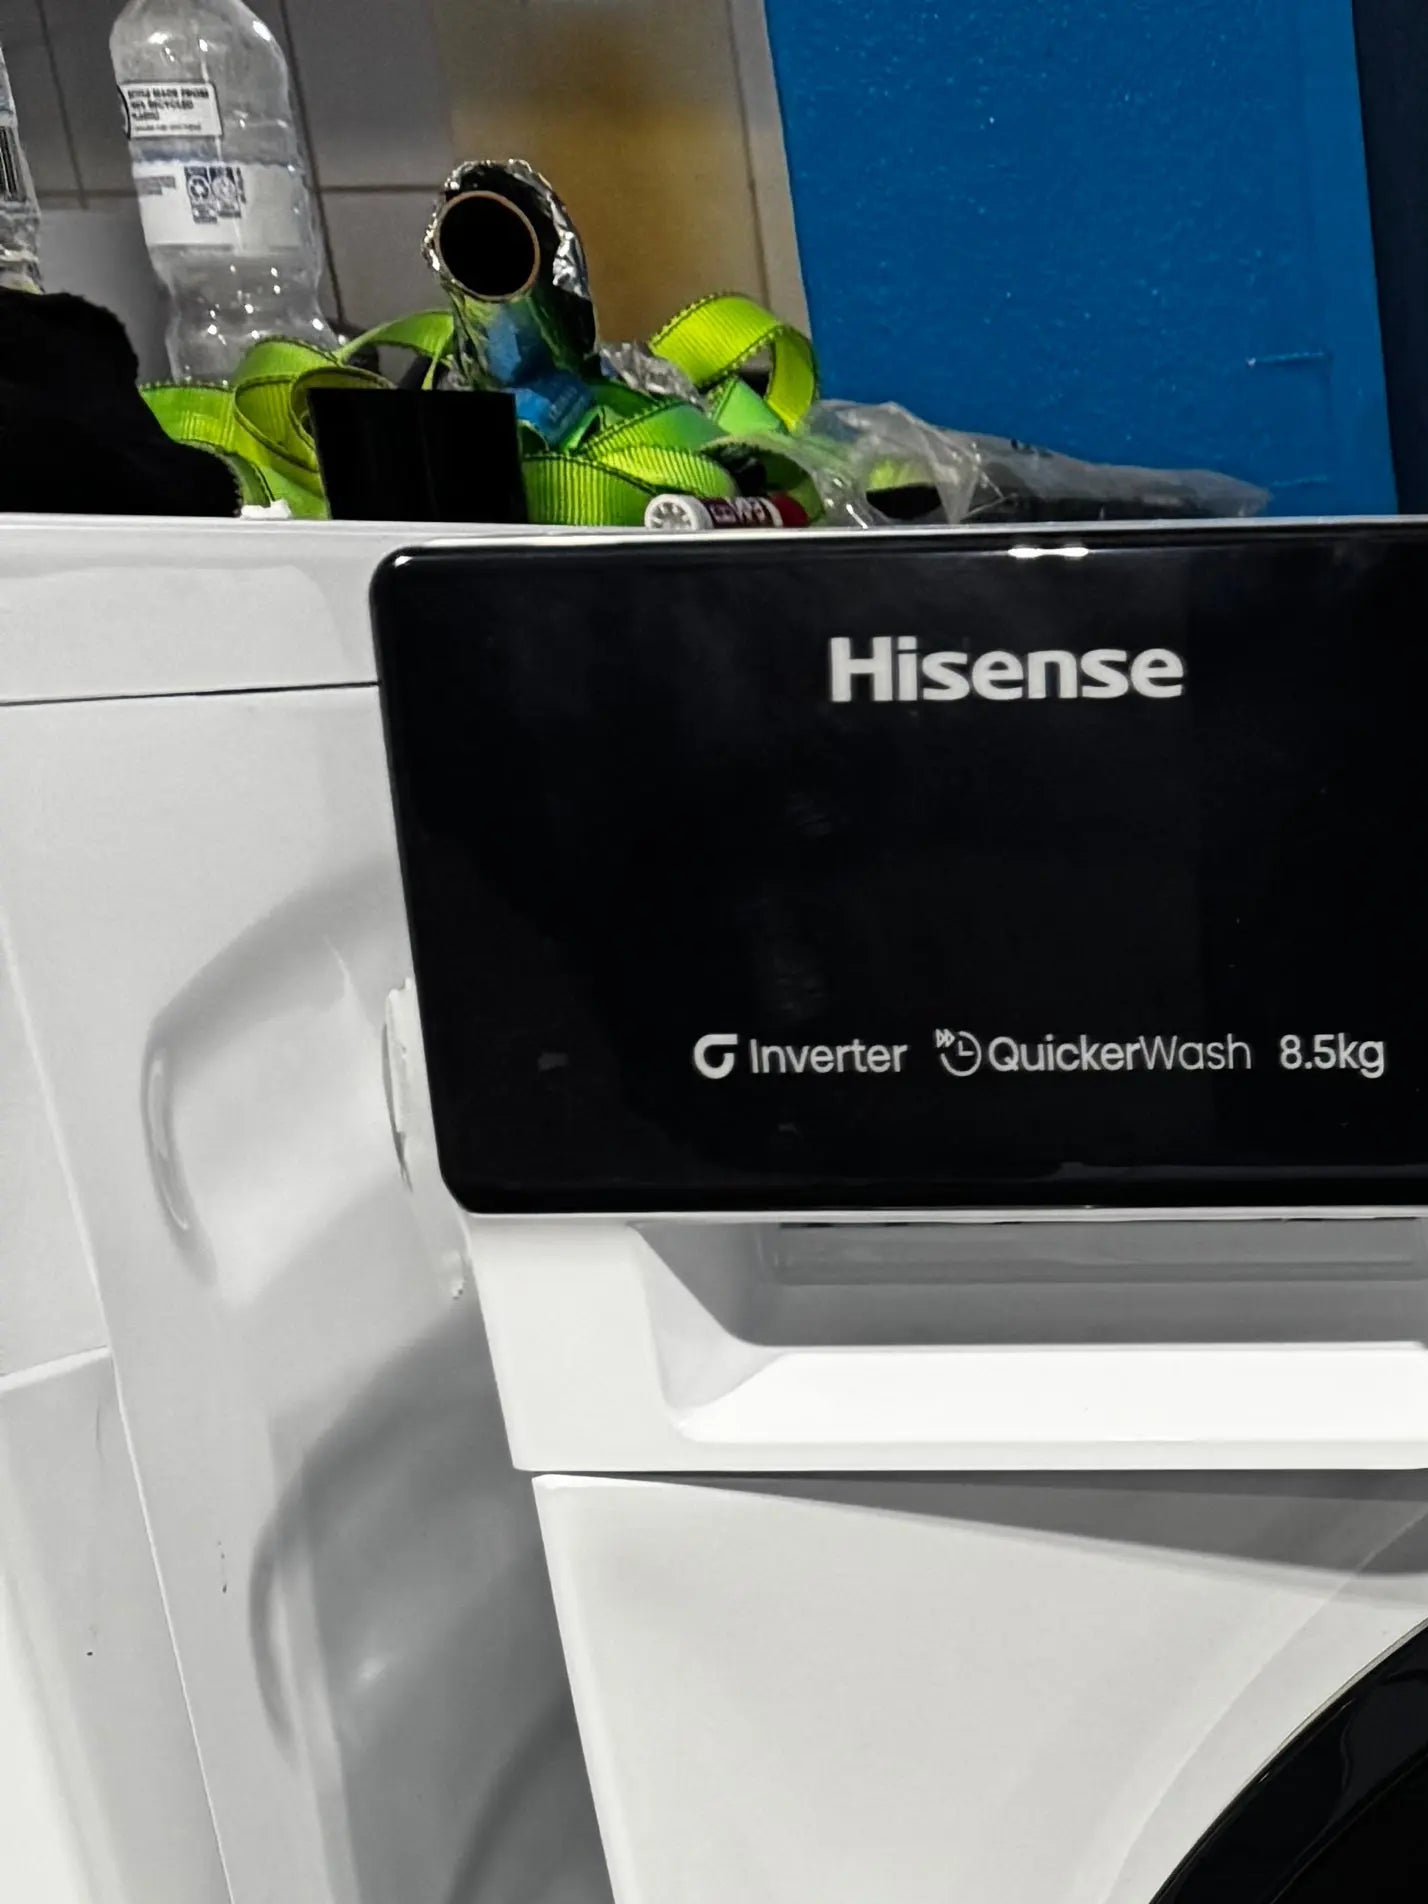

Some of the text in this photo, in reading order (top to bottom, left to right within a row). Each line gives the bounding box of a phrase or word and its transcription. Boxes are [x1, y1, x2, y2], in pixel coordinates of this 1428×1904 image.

[830, 636, 1184, 702] Hisense
[749, 1033, 1386, 1079] Inverter QuickerWash 8.5kg
